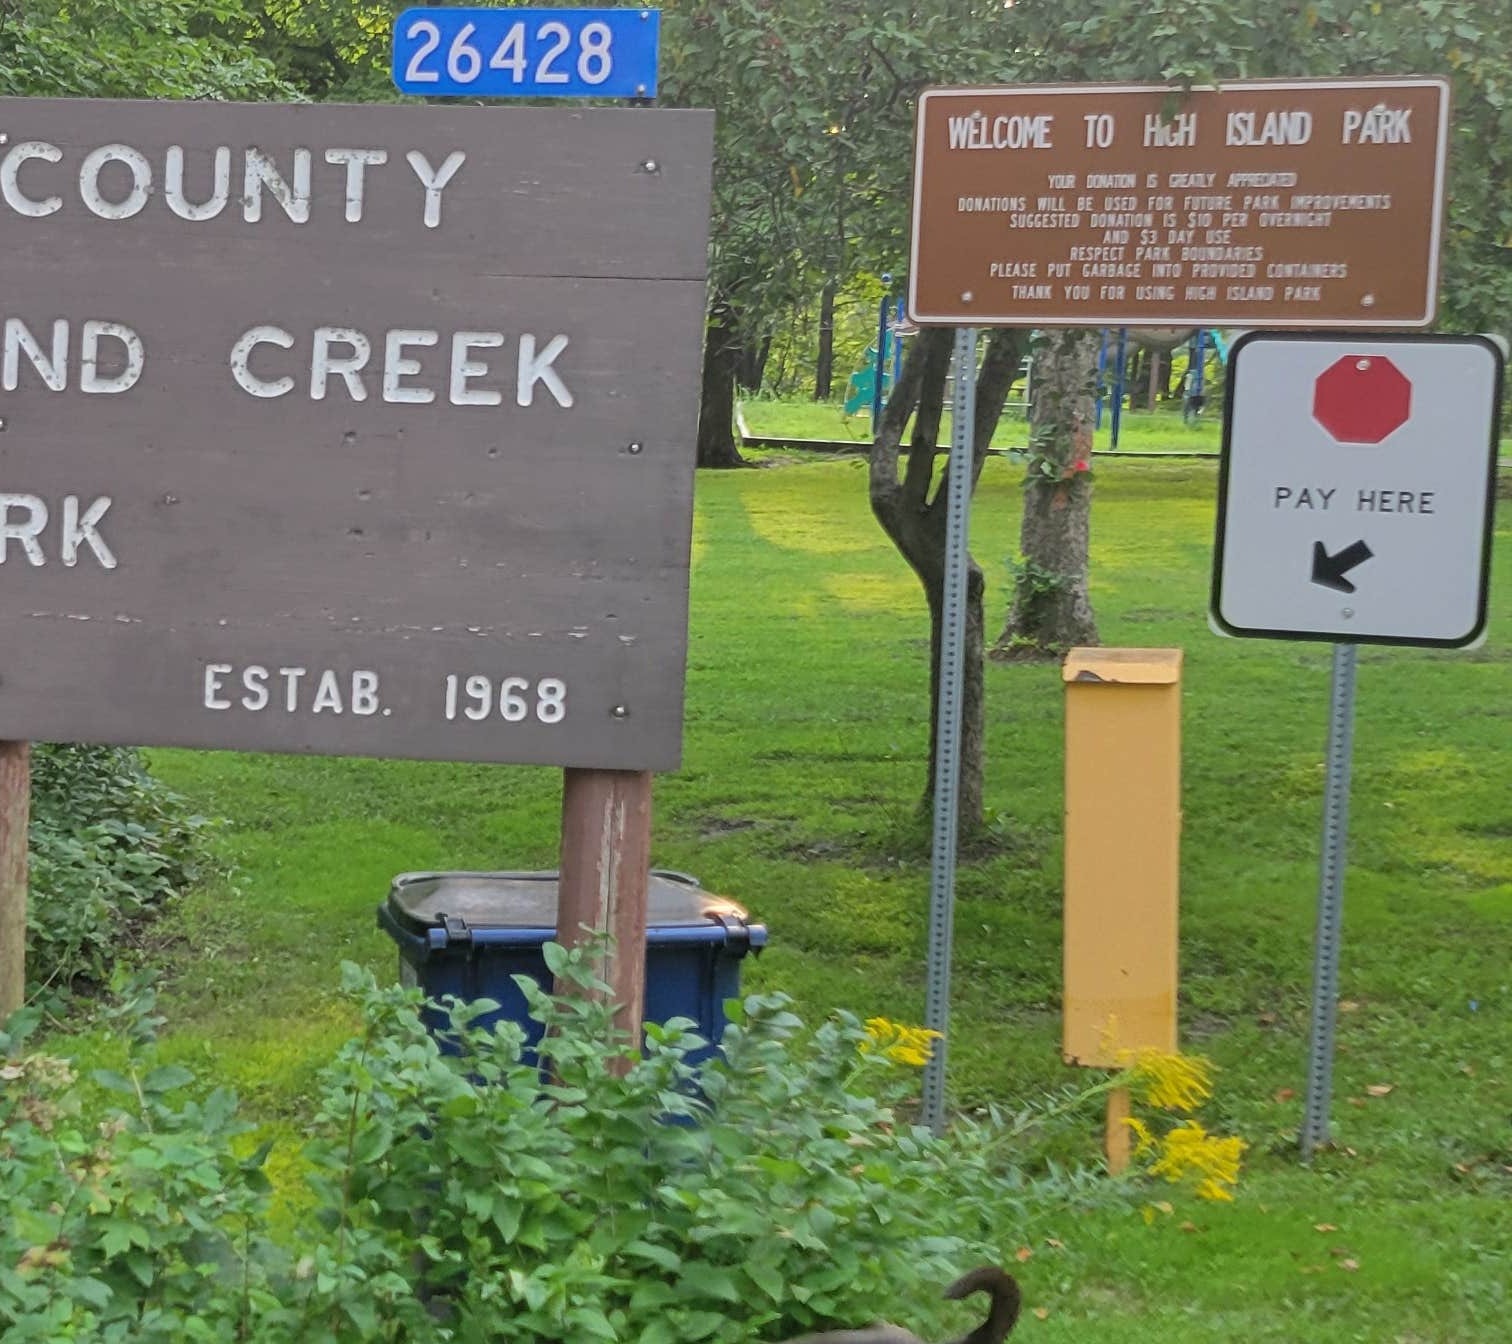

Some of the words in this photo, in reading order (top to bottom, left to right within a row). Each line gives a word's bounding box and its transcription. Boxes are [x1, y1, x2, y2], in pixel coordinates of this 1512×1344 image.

[405, 21, 612, 84] 26428
[948, 114, 1054, 149] WELCOME
[1083, 114, 1115, 148] TO
[1226, 111, 1312, 145] ISLAND
[1342, 108, 1412, 144] PARK
[0, 142, 466, 228] COUNTY
[1048, 174, 1076, 189] YOUR
[1086, 174, 1136, 188] DONATION
[1146, 174, 1158, 188] IS
[1169, 173, 1216, 188] GREATLY
[958, 197, 1026, 212] DONATIONS
[1038, 197, 1066, 211] WILL
[1077, 196, 1094, 211] BE
[1104, 196, 1137, 211] USED
[1148, 196, 1174, 211] FOR
[1184, 196, 1232, 211] FUTURE
[1243, 196, 1280, 210] PARK
[1290, 195, 1392, 209] IMPROVEMENTS
[1010, 213, 1080, 228] SUGGESTED
[1090, 213, 1153, 228] DONATION
[1163, 213, 1177, 227] IS
[1188, 212, 1213, 228] $10
[1222, 213, 1249, 227] PER
[1259, 212, 1332, 227] OVERNIGHT
[1103, 230, 1129, 244] AND
[1140, 229, 1157, 245] $3
[1168, 230, 1194, 244] DAY
[1206, 230, 1232, 244] USE
[1070, 247, 1125, 261] RESPECT
[1136, 247, 1171, 261] PARK
[1181, 247, 1264, 261] BOUNDARIES
[990, 263, 1037, 277] PLEASE
[1048, 263, 1072, 277] PUT
[1082, 263, 1141, 278] GARBAGE
[1152, 264, 1183, 278] INTO
[1192, 264, 1256, 278] PROVIDED
[1267, 264, 1347, 278] CONTAINERS
[1012, 285, 1052, 300] THANK
[1064, 286, 1090, 300] YOU
[1100, 286, 1125, 300] FOR
[1136, 286, 1175, 301] USING
[1185, 286, 1217, 301] HIGH
[1227, 286, 1274, 301] ISLAND
[1285, 286, 1321, 301] PARK
[230, 325, 574, 408] CREEK
[1274, 487, 1336, 510] PAY
[1357, 490, 1435, 514] HERE
[203, 664, 391, 716] ESTAB.
[444, 675, 567, 724] 1968
